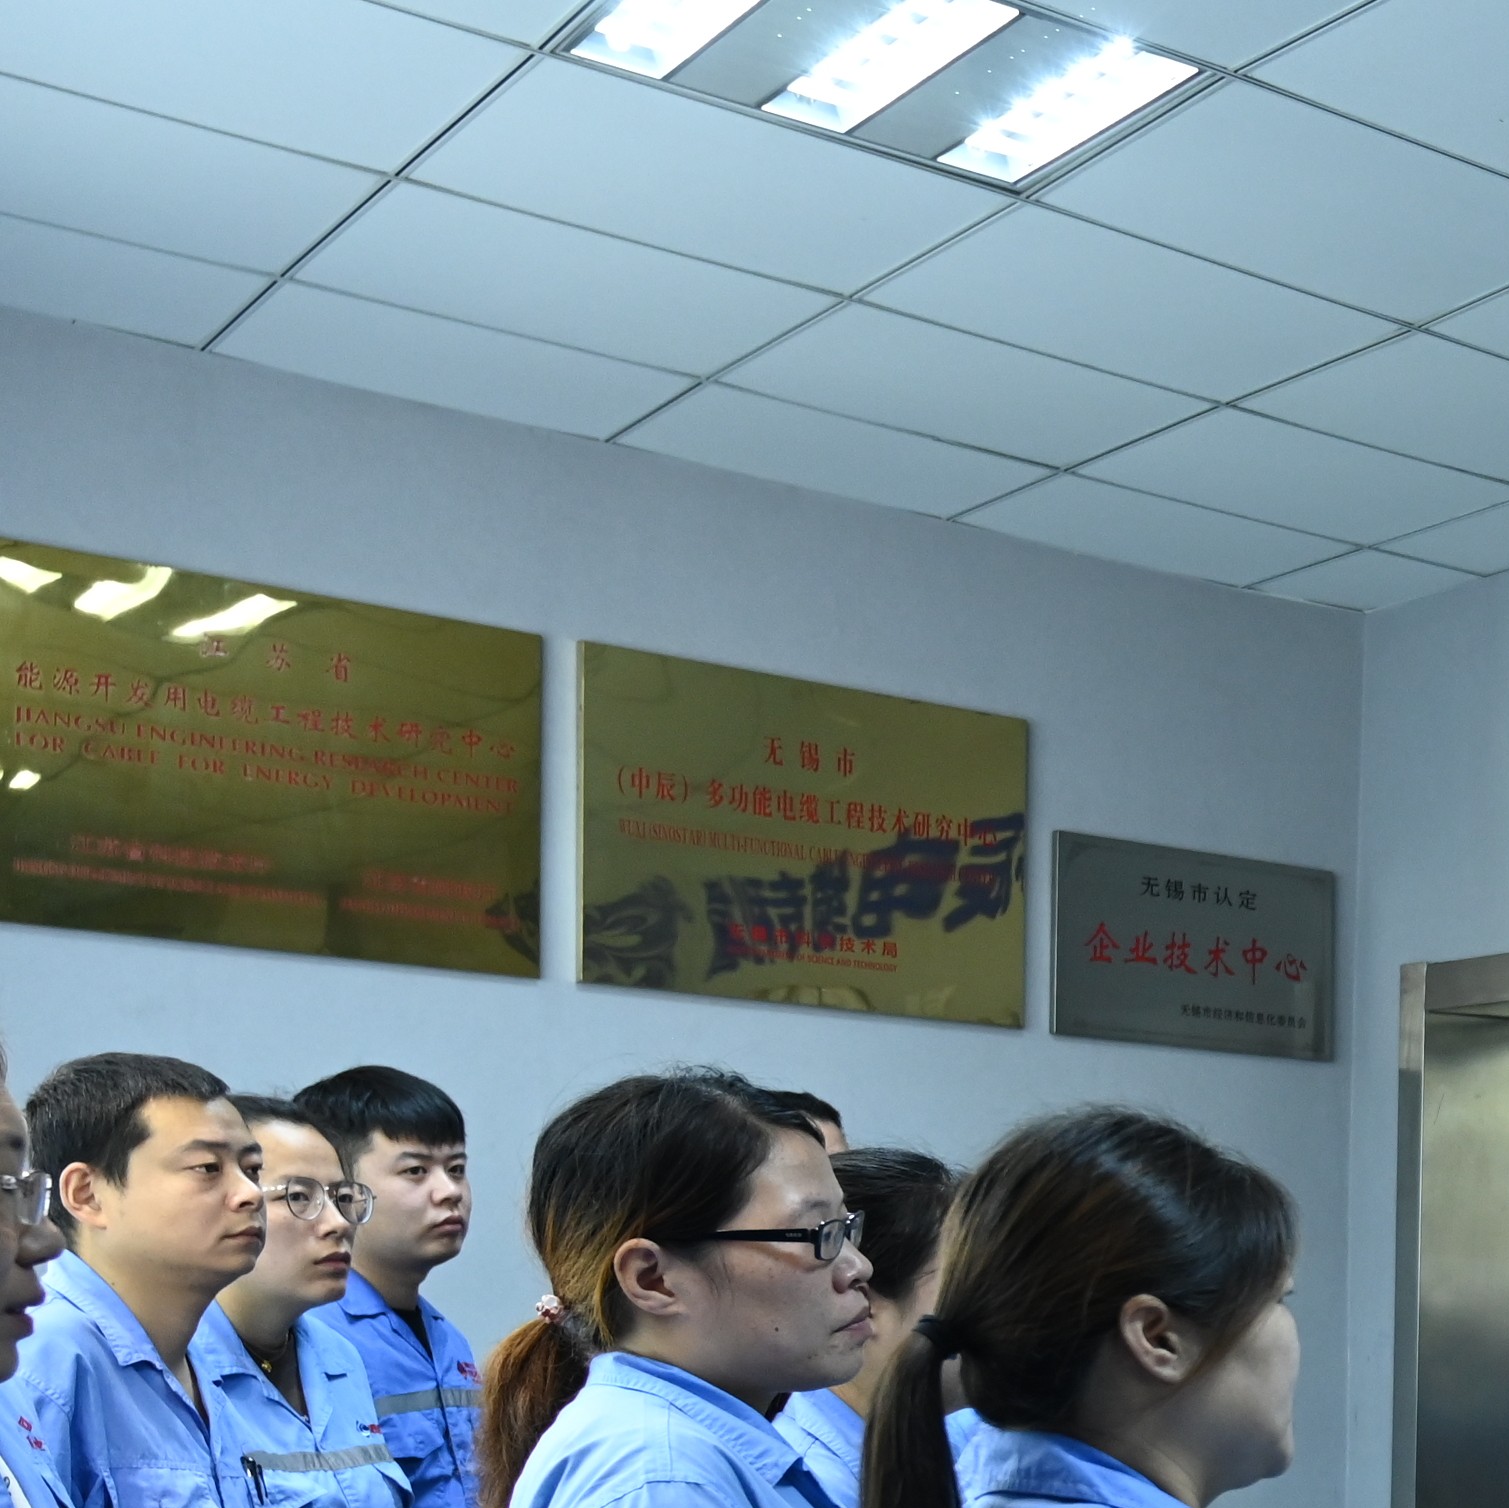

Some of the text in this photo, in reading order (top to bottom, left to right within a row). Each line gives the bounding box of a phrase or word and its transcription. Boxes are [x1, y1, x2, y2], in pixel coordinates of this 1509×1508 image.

[201, 635, 352, 683] 江苏省
[15, 731, 514, 816] FOR CABLE FOR ENERGY DEVELOPMENT
[763, 736, 855, 777] 无锡市
[437, 769, 519, 793] CENTER
[1140, 876, 1257, 911] 无锡市认定
[728, 921, 898, 959] 无市科技术局
[1084, 922, 1307, 986] 企业技术中心
